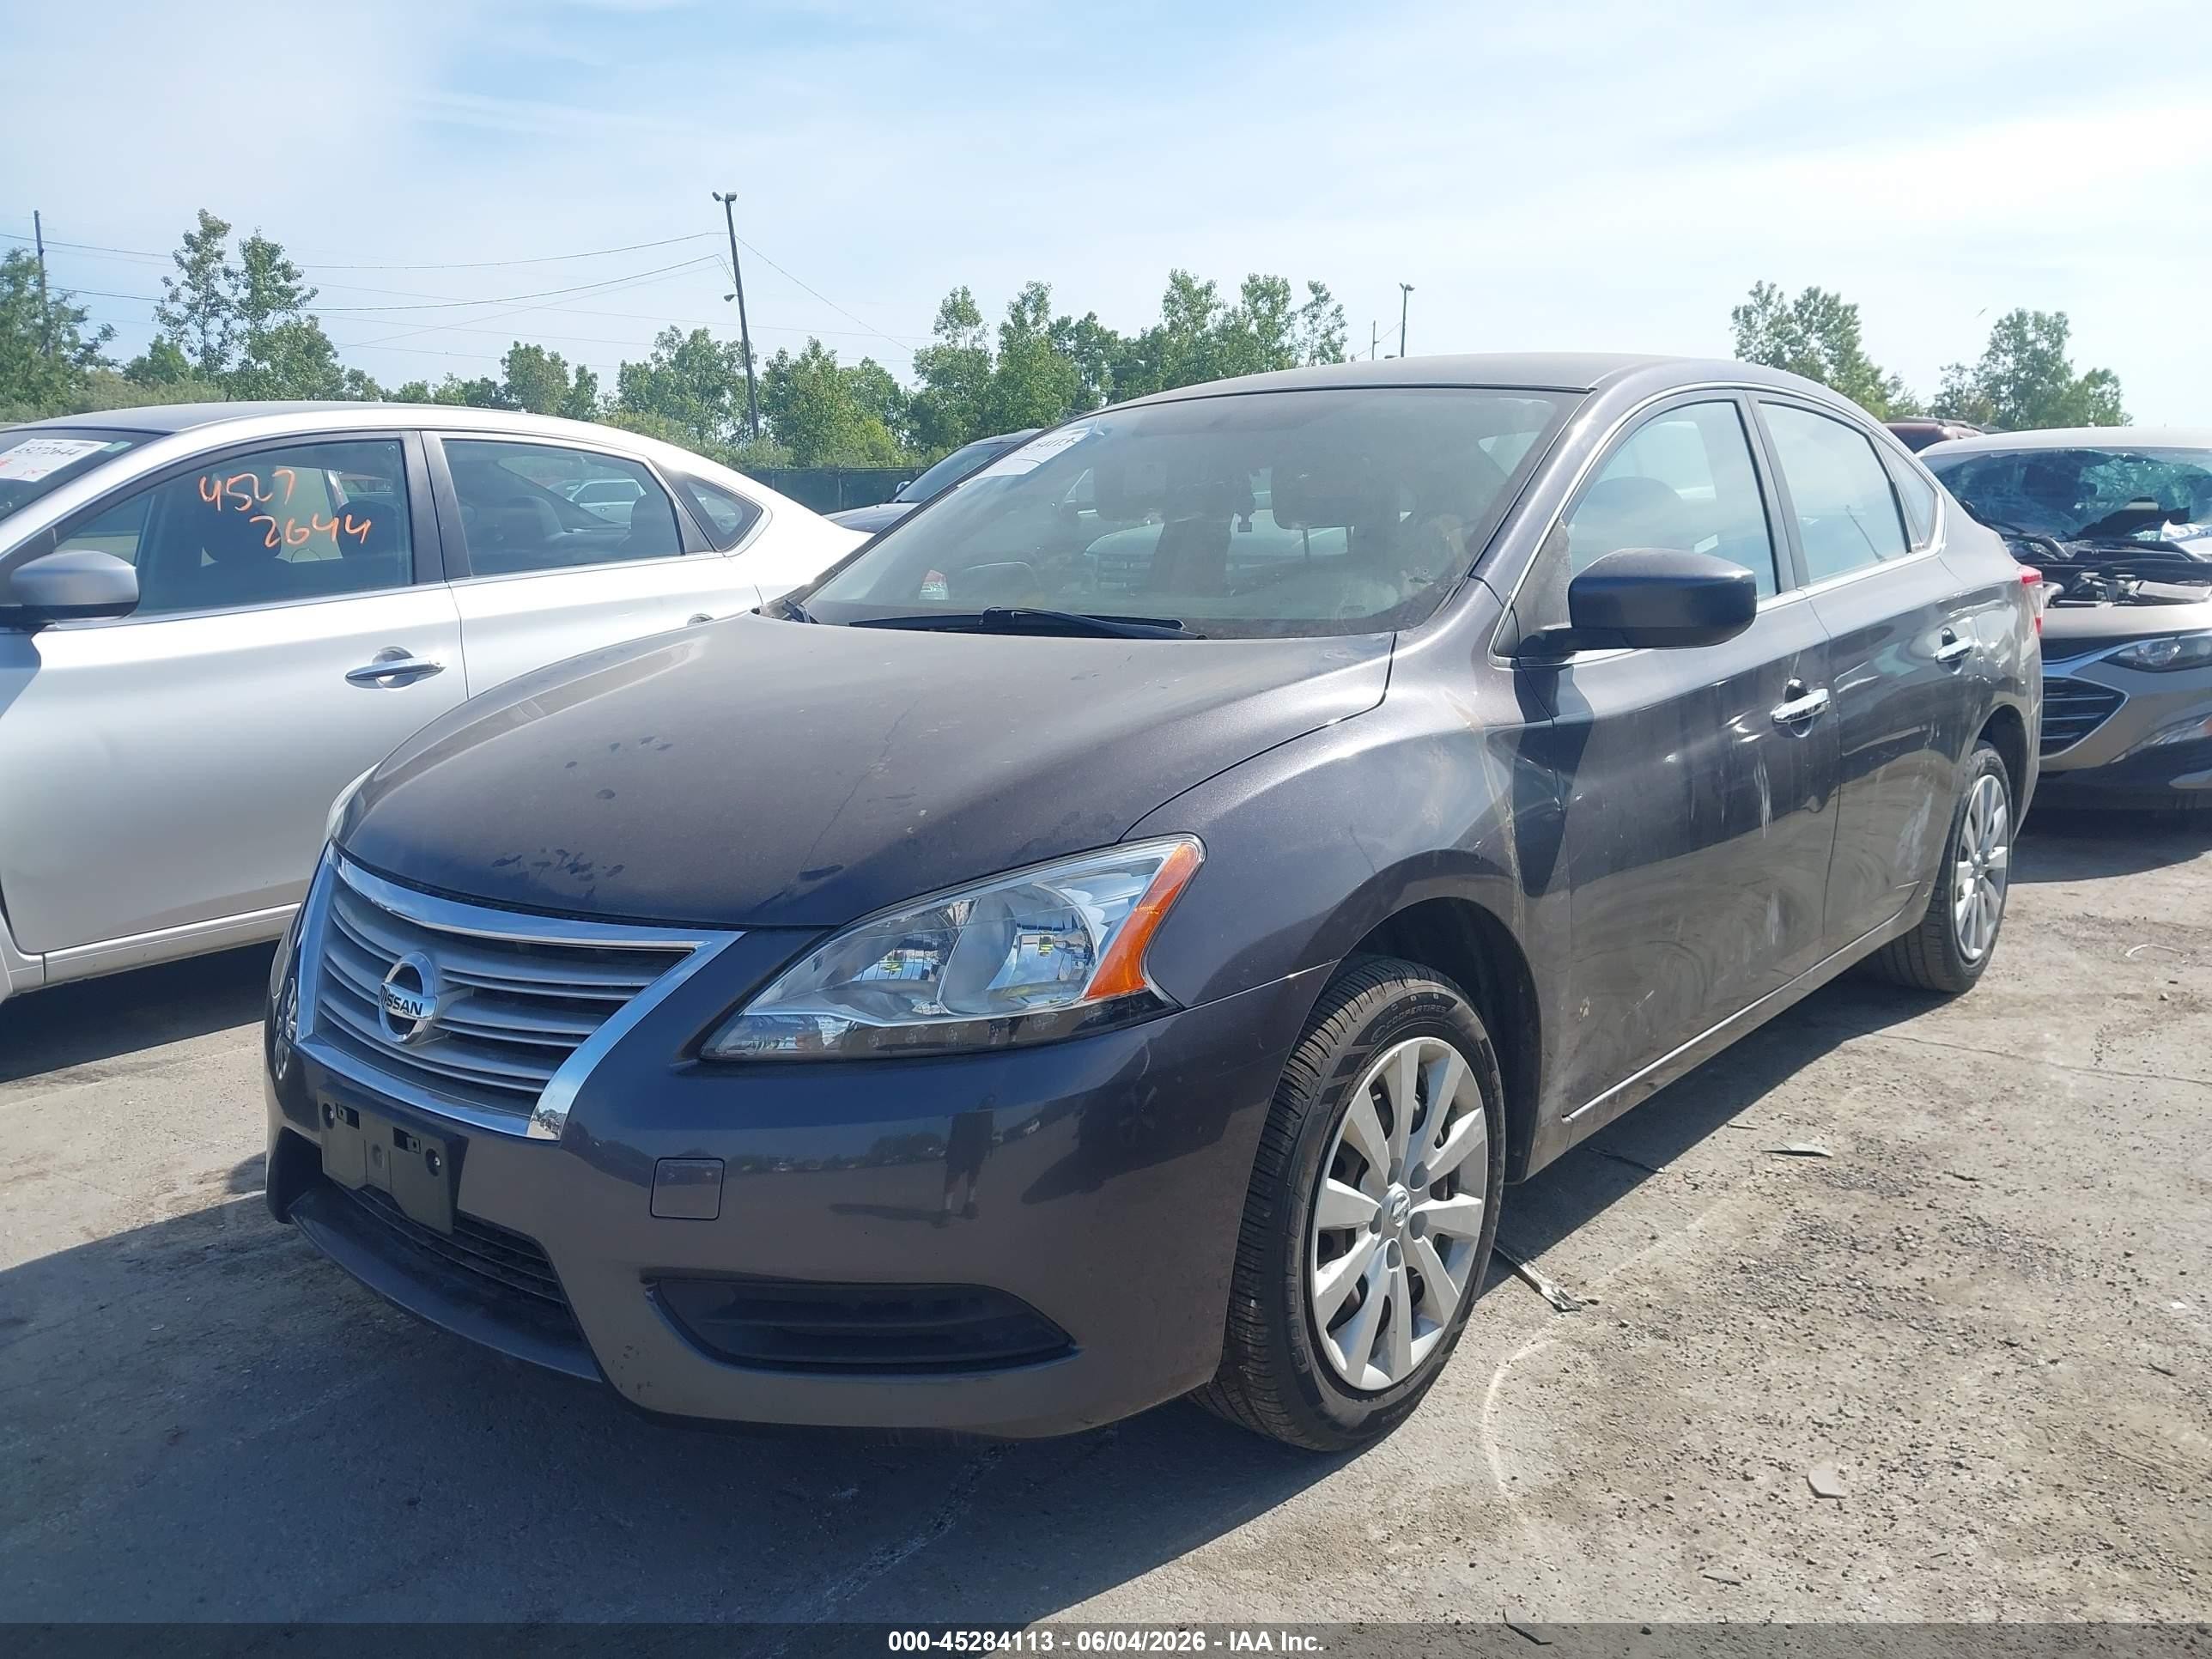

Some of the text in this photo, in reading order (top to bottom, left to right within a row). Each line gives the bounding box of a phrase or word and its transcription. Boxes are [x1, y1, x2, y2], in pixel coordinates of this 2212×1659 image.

[198, 469, 295, 512] 4527
[249, 513, 372, 548] 2644
[380, 984, 423, 1016] NISSAN
